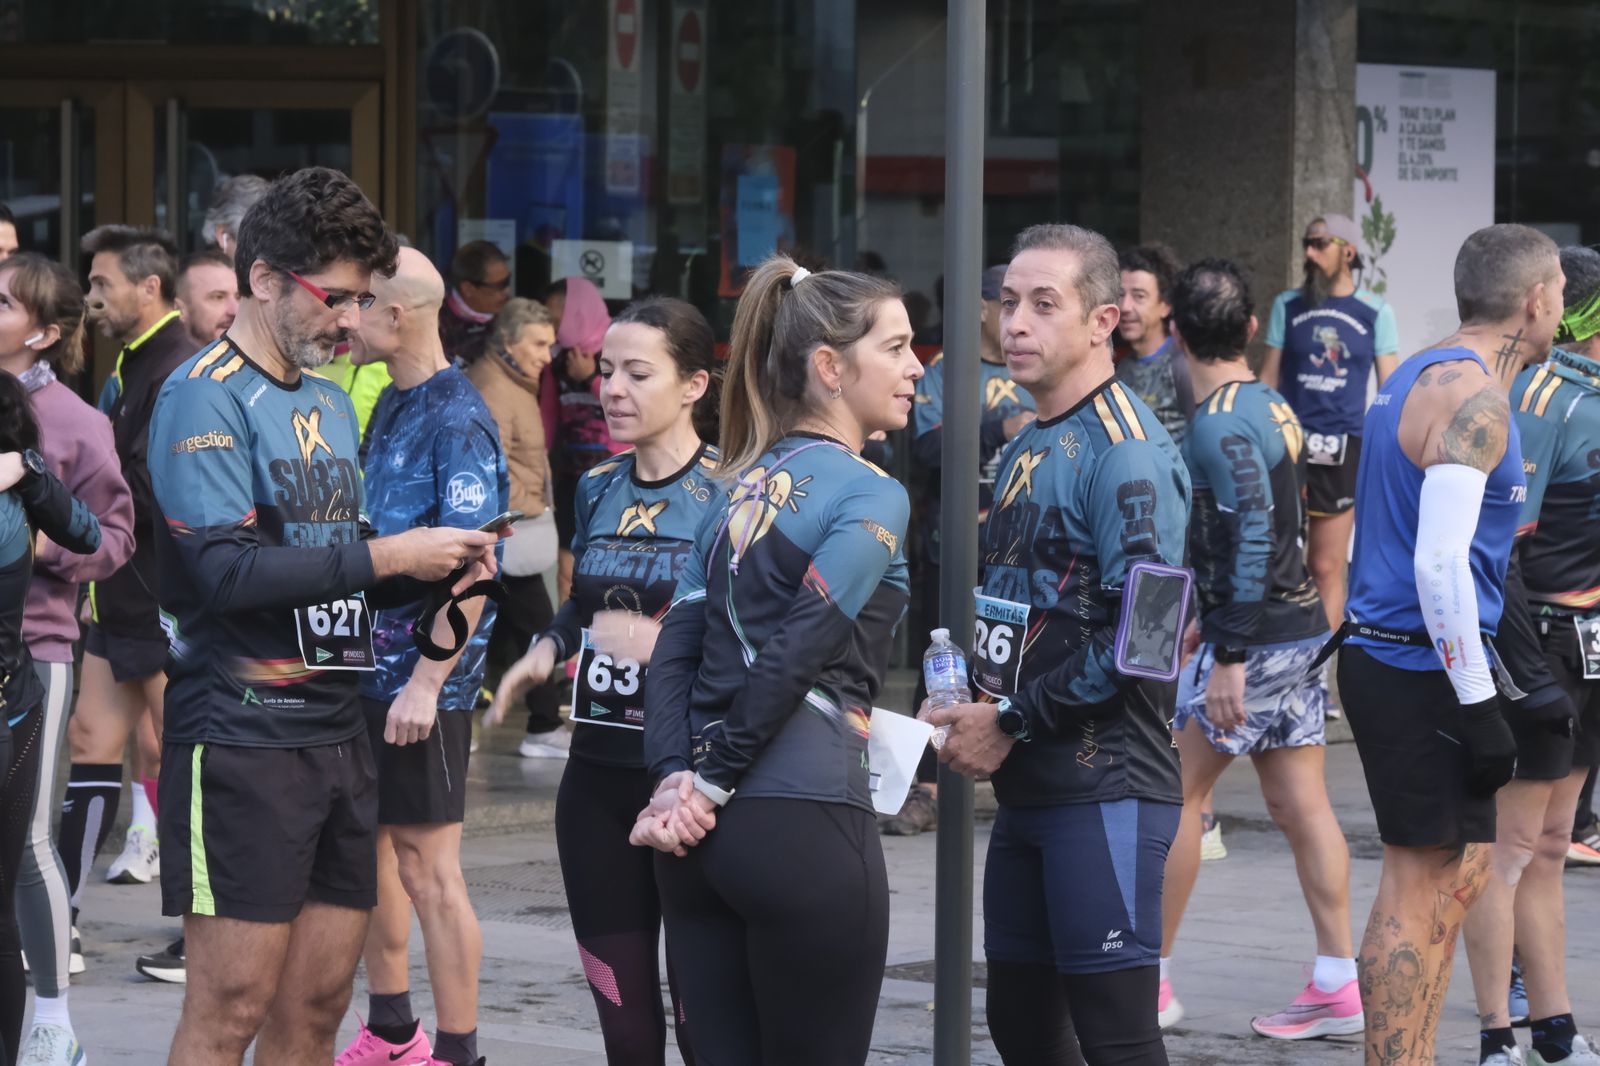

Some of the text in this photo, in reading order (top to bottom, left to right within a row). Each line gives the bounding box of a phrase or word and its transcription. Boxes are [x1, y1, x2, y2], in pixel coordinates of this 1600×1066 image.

[1399, 106, 1456, 121] TRAE TU PLAN
[1399, 122, 1443, 135] A CAJASUR
[1406, 137, 1417, 150] TE
[1419, 138, 1446, 151] DAMOS
[1398, 167, 1458, 181] DE SU IMPORTE
[171, 429, 234, 453] surgestión
[1058, 431, 1082, 459] SIG
[451, 479, 487, 506] Buff
[682, 478, 711, 502] SIG
[324, 488, 351, 522] las
[308, 599, 362, 637] 627
[984, 603, 1025, 623] ERMITAS
[973, 619, 1014, 664] 26
[1373, 629, 1410, 642] Kalenji
[587, 654, 648, 696] 63
